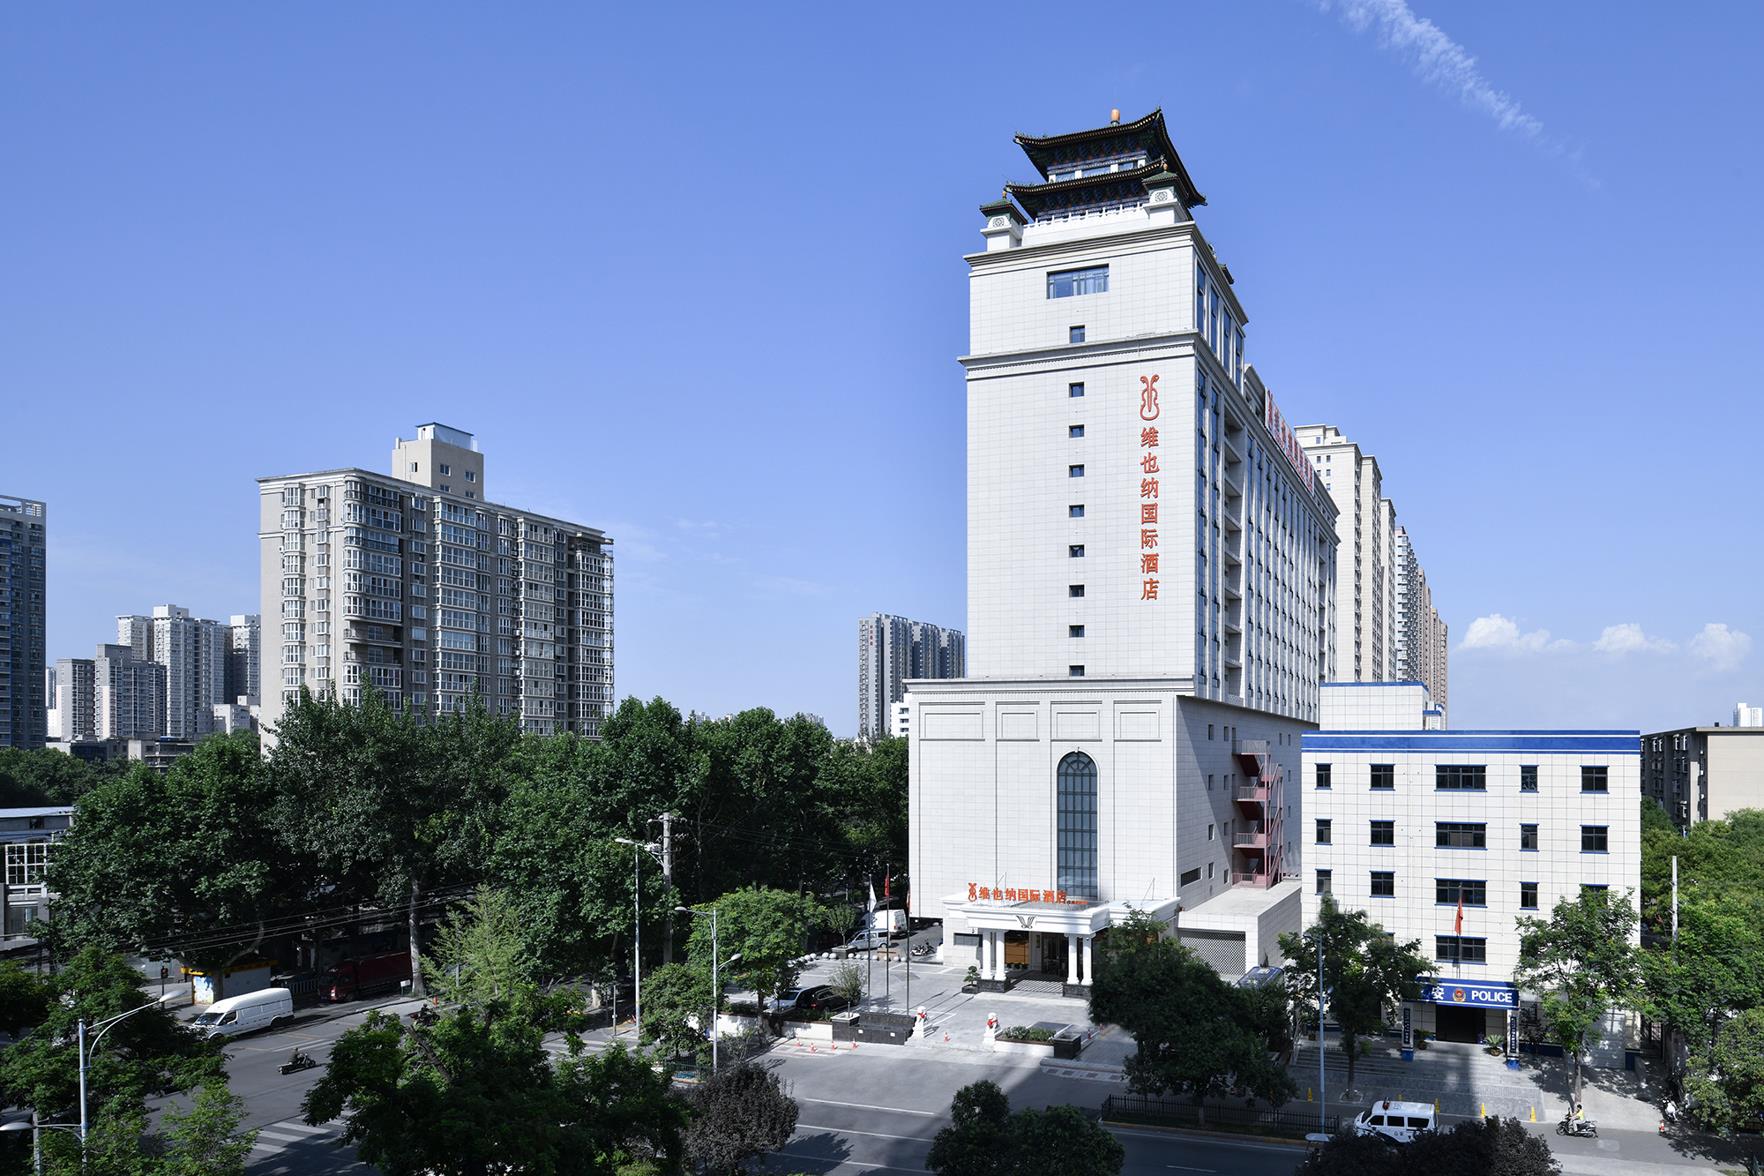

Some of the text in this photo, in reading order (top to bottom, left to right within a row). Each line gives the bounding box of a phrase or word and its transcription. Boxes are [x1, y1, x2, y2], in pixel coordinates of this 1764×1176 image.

[1140, 427, 1160, 600] 维也纳国际酒店
[979, 886, 1067, 904] 维也纳国际酒店
[1471, 990, 1513, 1003] POLICE
